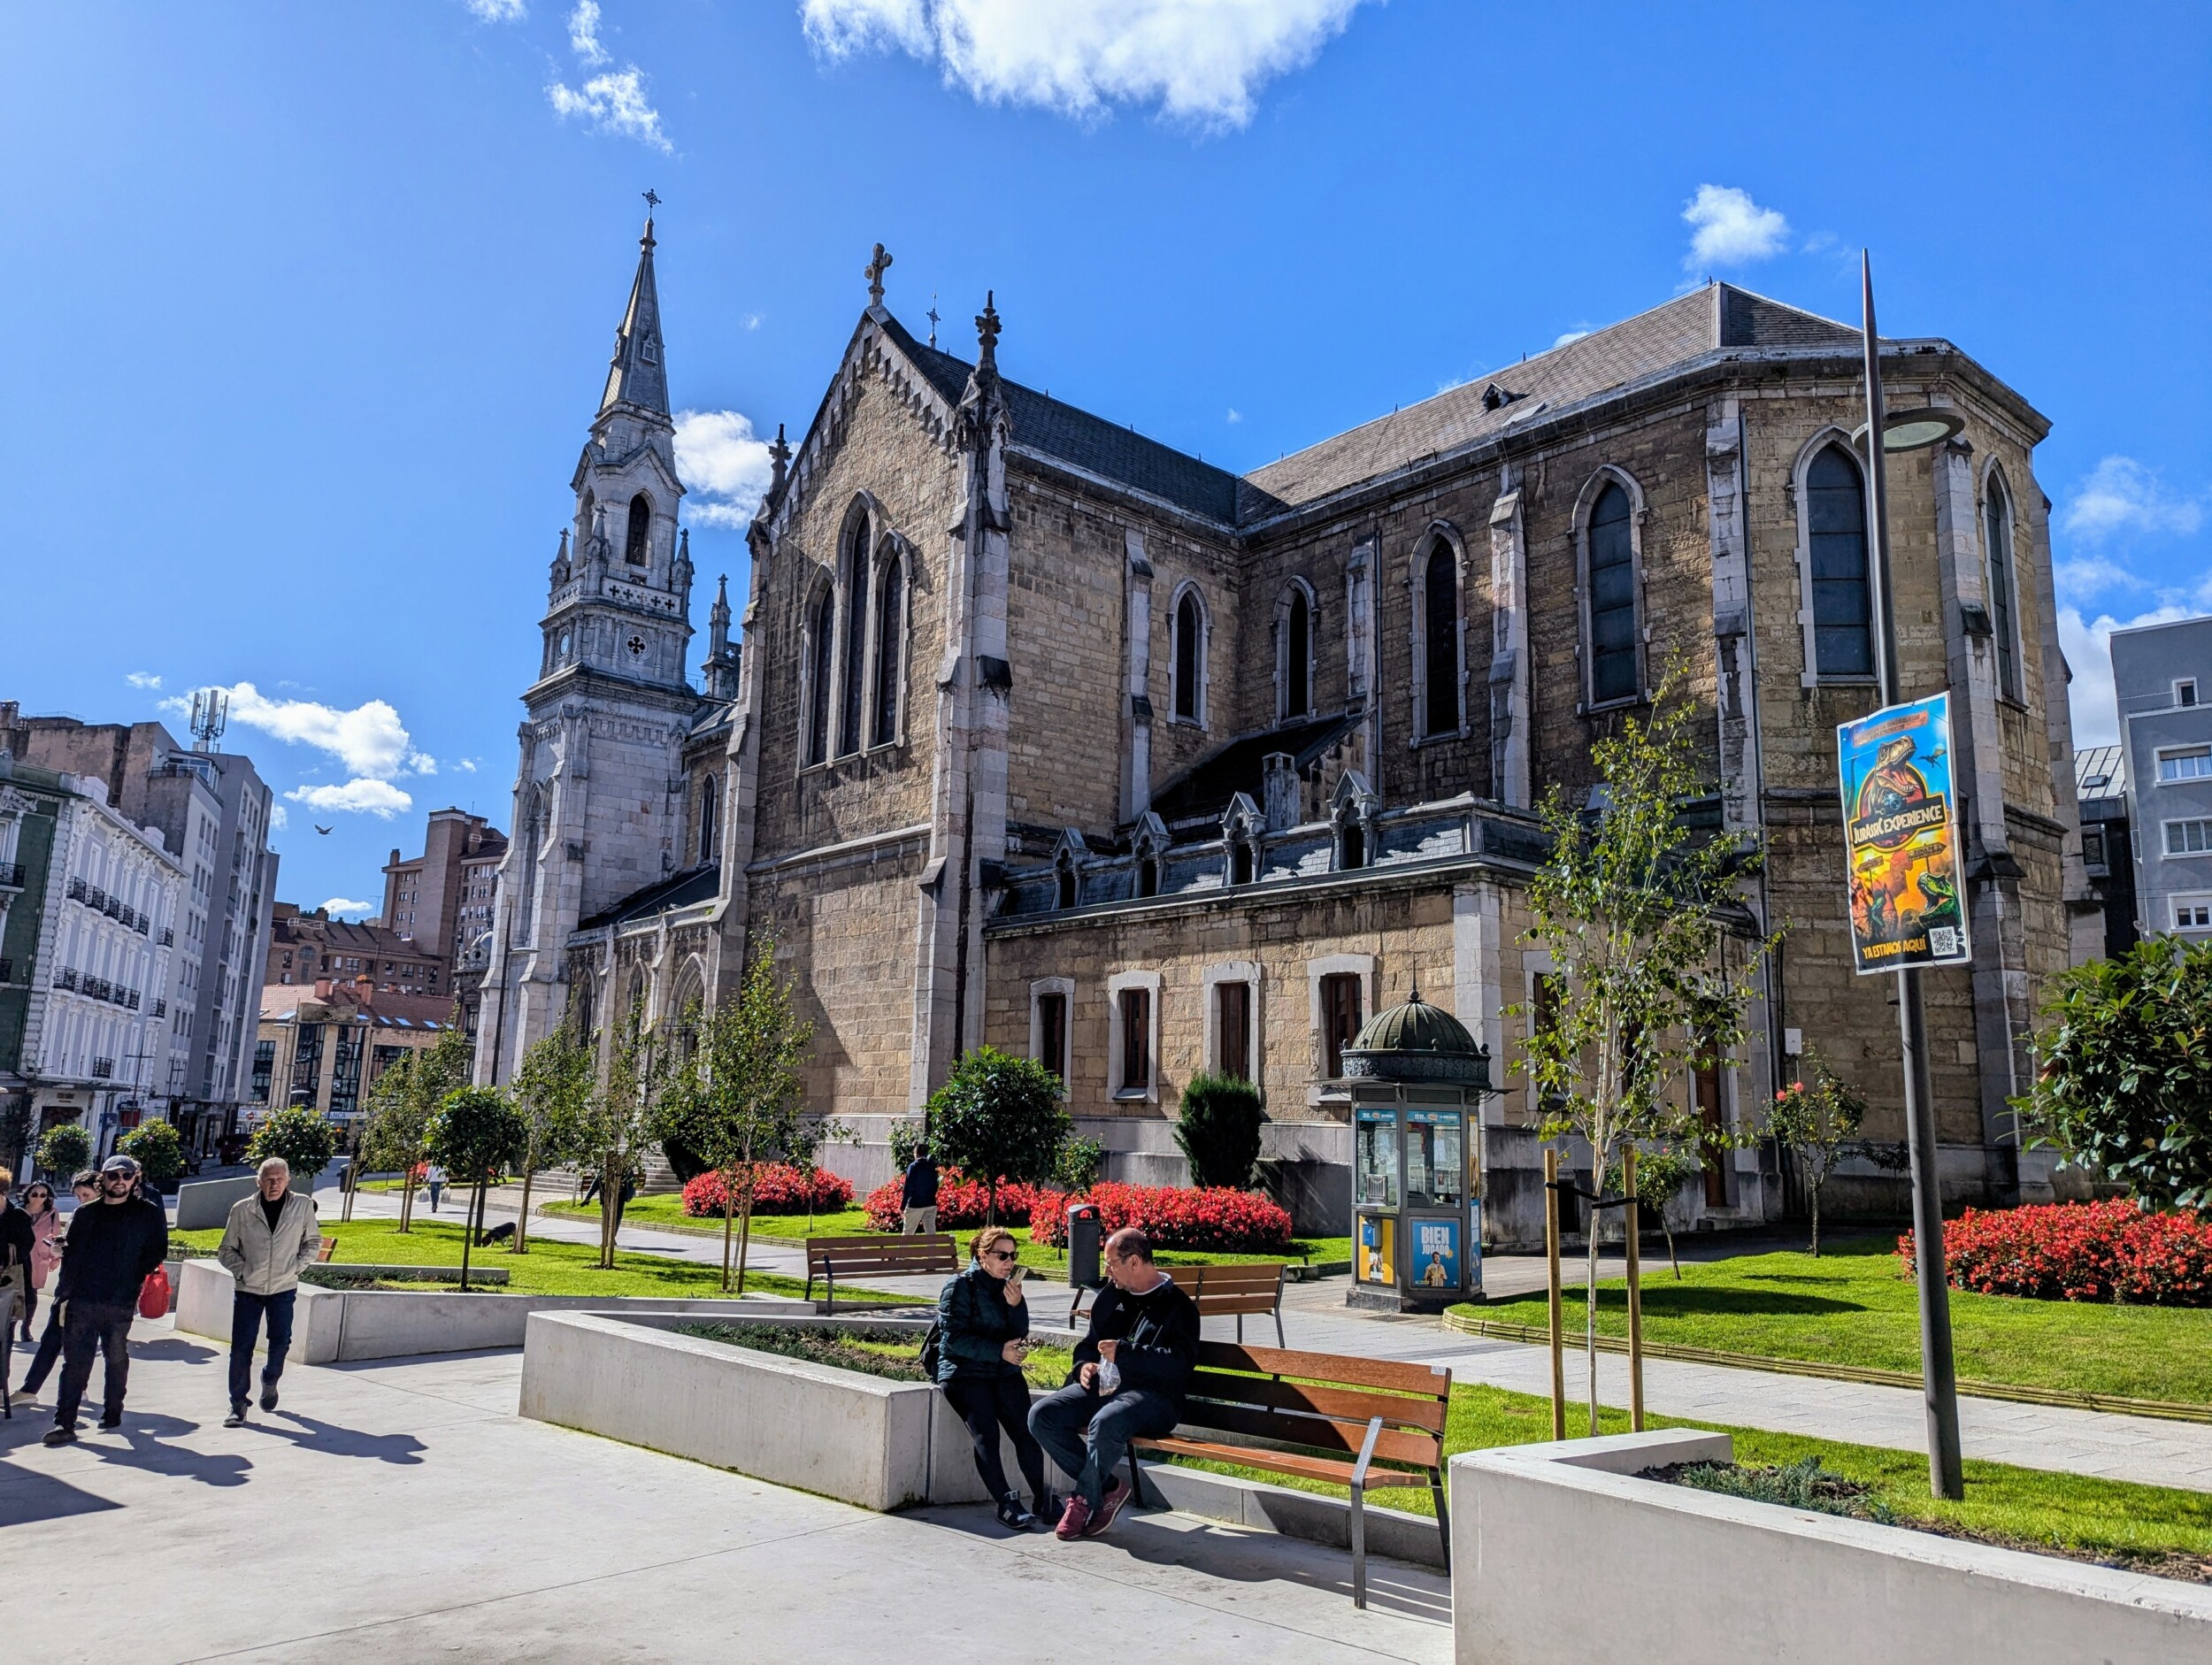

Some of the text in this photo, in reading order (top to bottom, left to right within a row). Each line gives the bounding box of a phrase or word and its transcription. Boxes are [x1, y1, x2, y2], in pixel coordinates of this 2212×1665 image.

[1854, 804, 1943, 844] JURASSIC EXPERIENCE
[1863, 934, 1927, 959] YA ESTAMOS AQUÍ
[1421, 1226, 1449, 1245] BIEN
[1422, 1244, 1449, 1255] JUGADO
